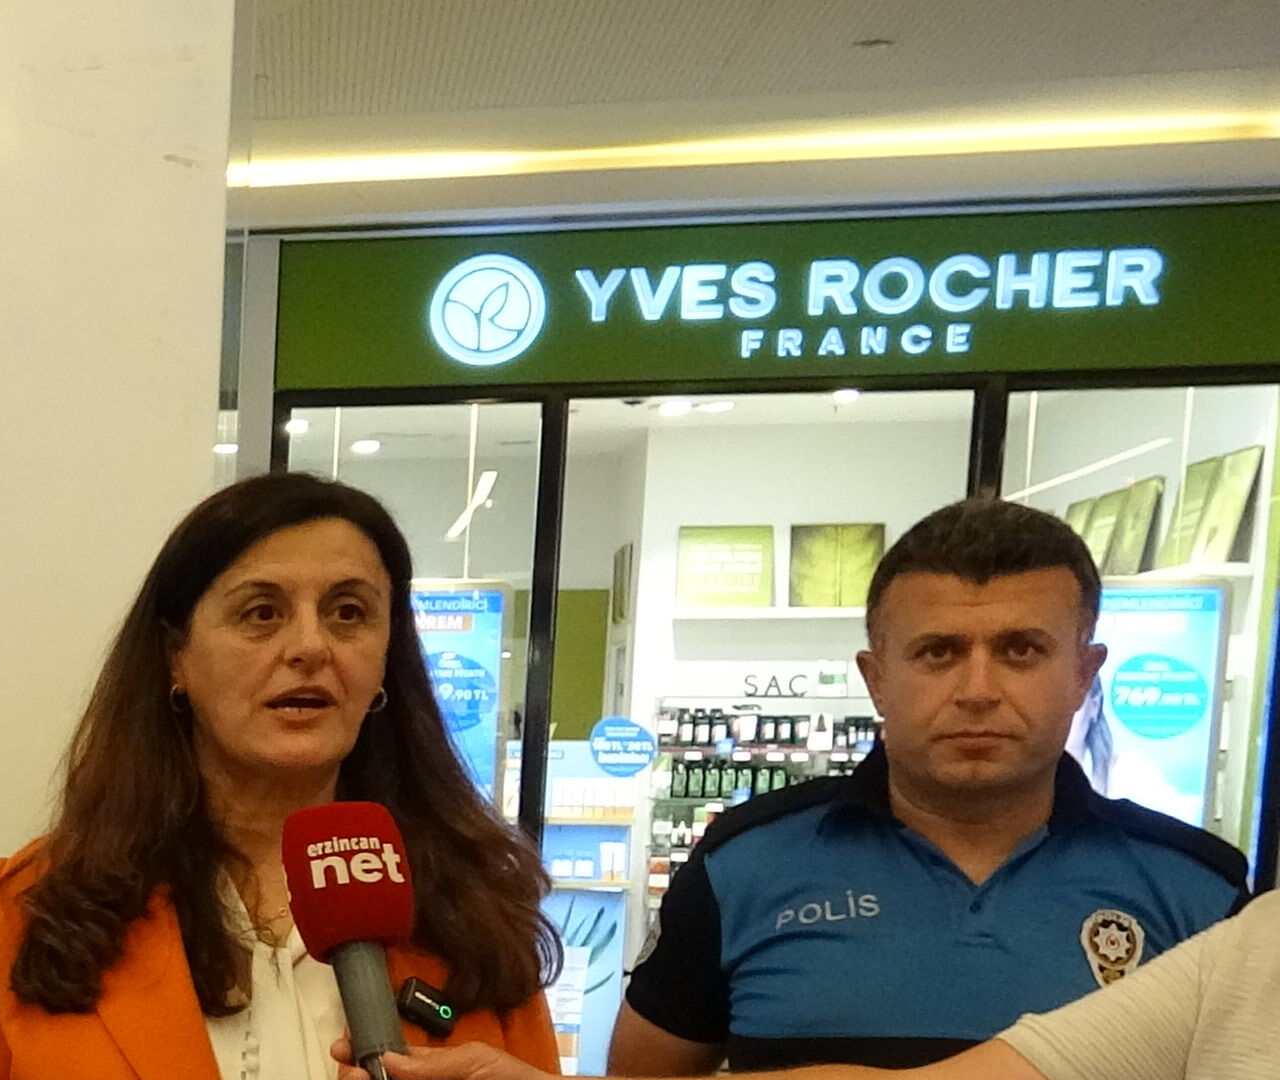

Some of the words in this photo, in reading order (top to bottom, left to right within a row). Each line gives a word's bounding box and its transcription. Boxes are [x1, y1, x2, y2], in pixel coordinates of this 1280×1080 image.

[574, 261, 777, 322] YVES
[807, 247, 1165, 316] ROCHER
[740, 323, 972, 358] FRANCE
[307, 836, 380, 857] erzincan
[310, 843, 405, 889] net
[775, 889, 881, 930] POLİS
